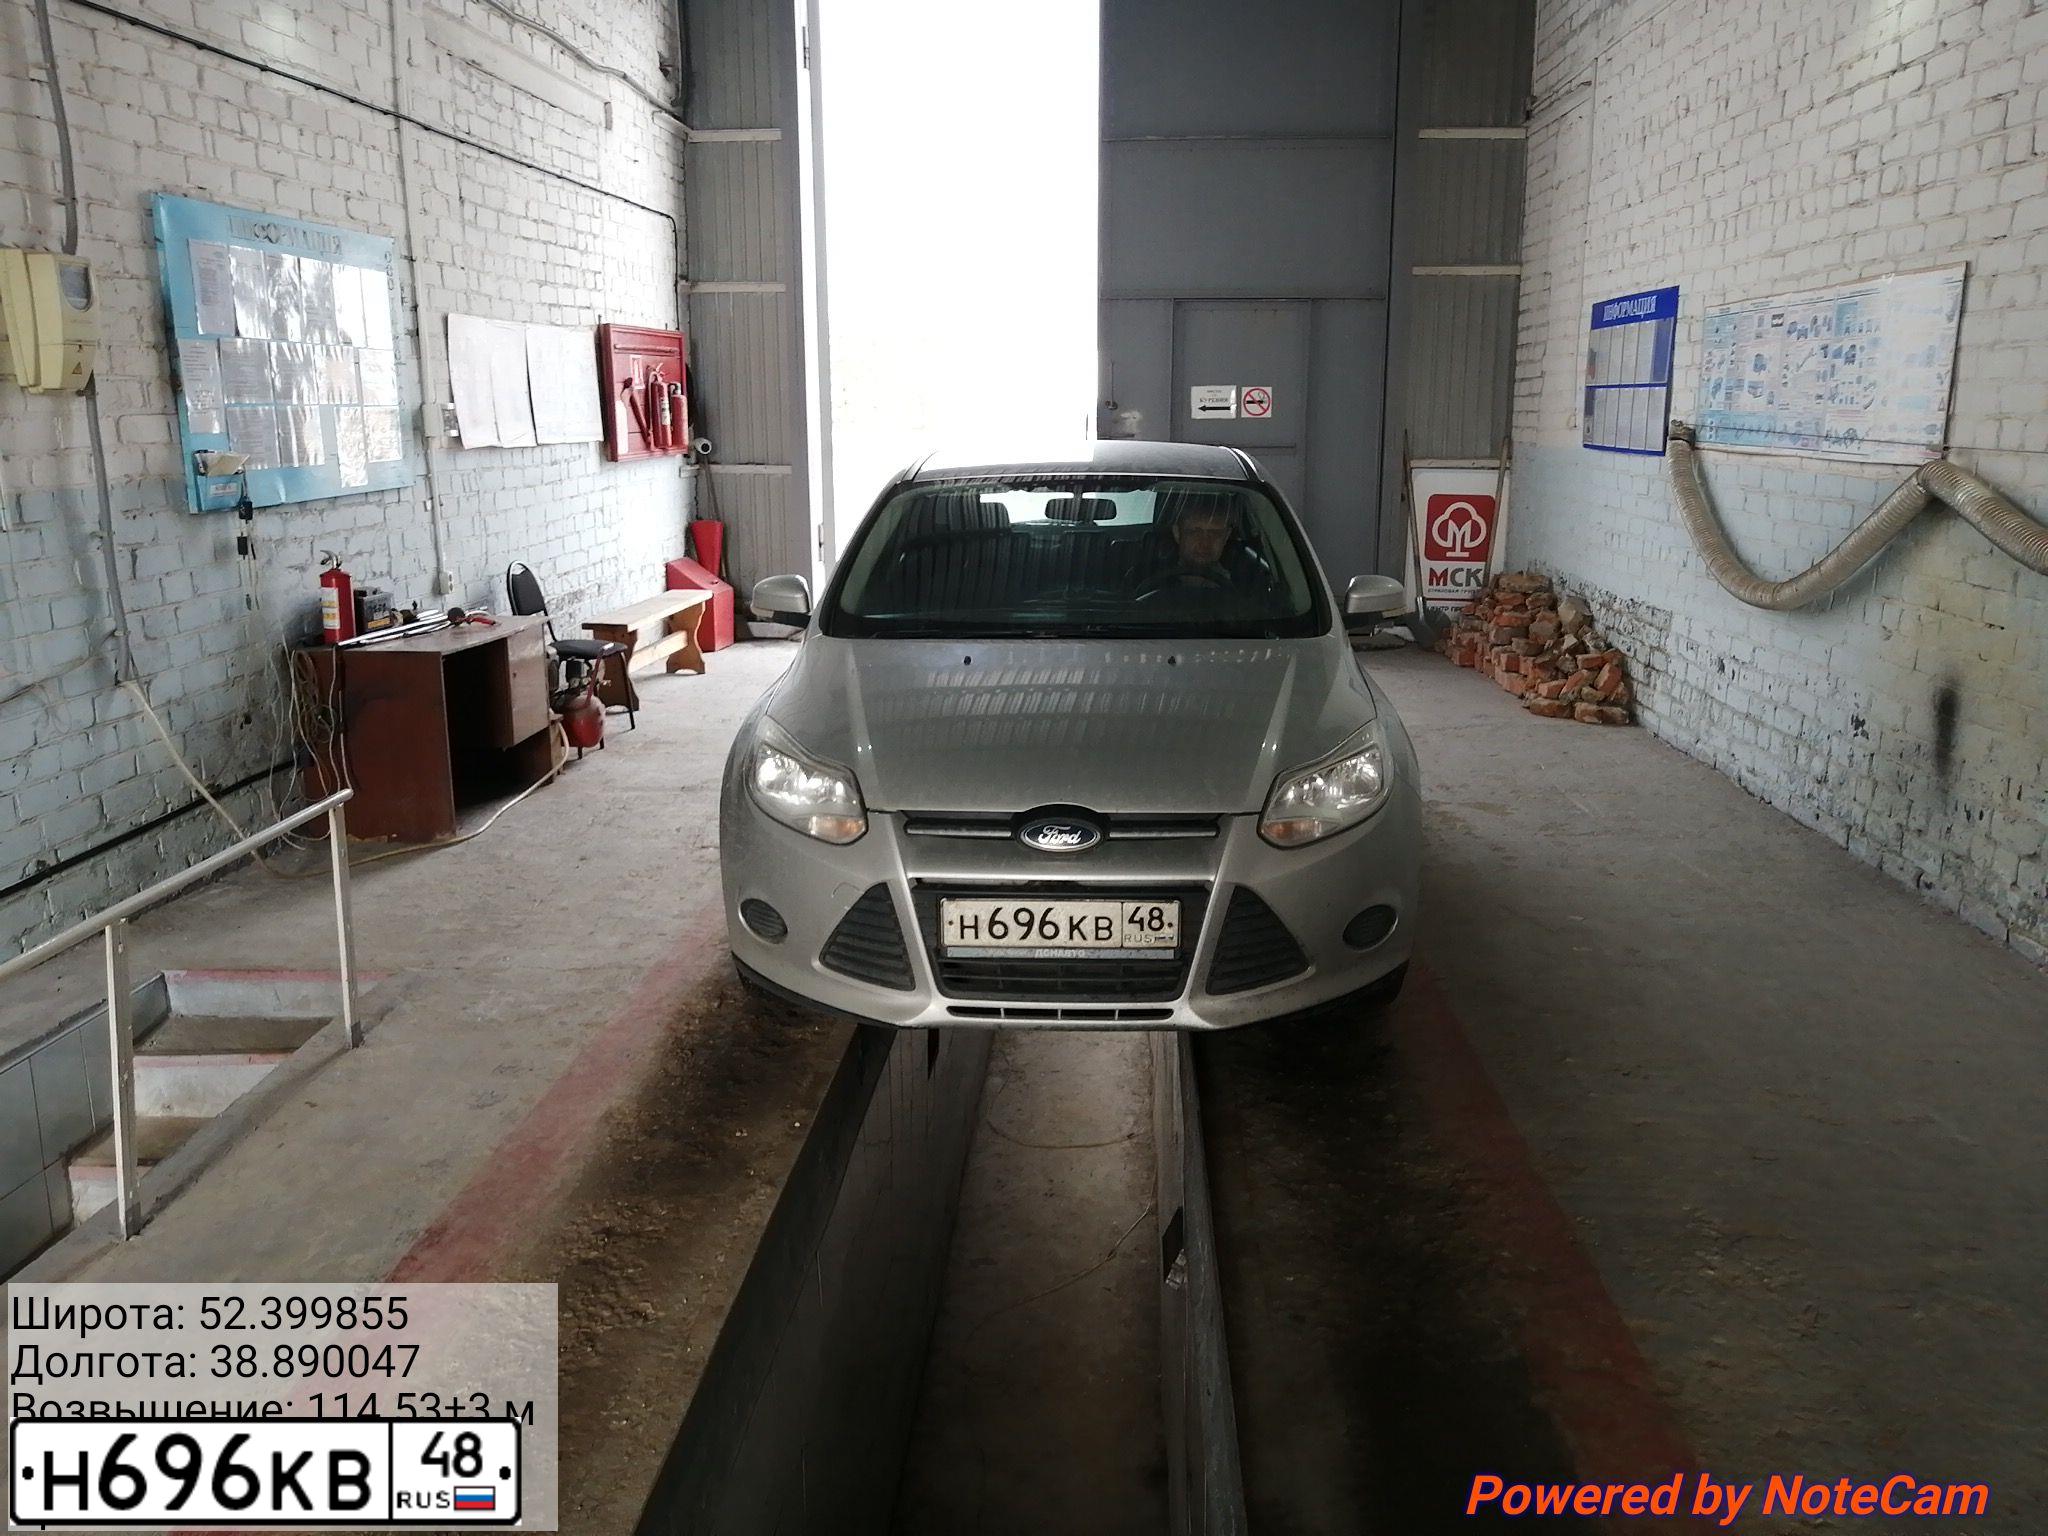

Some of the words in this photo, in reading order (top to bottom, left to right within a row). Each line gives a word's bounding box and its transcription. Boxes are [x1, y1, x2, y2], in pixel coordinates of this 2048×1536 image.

[1602, 295, 1658, 321] ИНФОРМАЦИЯ
[1428, 567, 1483, 587] МСК
[1038, 825, 1082, 845] Ford
[959, 907, 1113, 941] Н696КВ
[1128, 906, 1165, 932] 48
[1124, 934, 1153, 943] RUS
